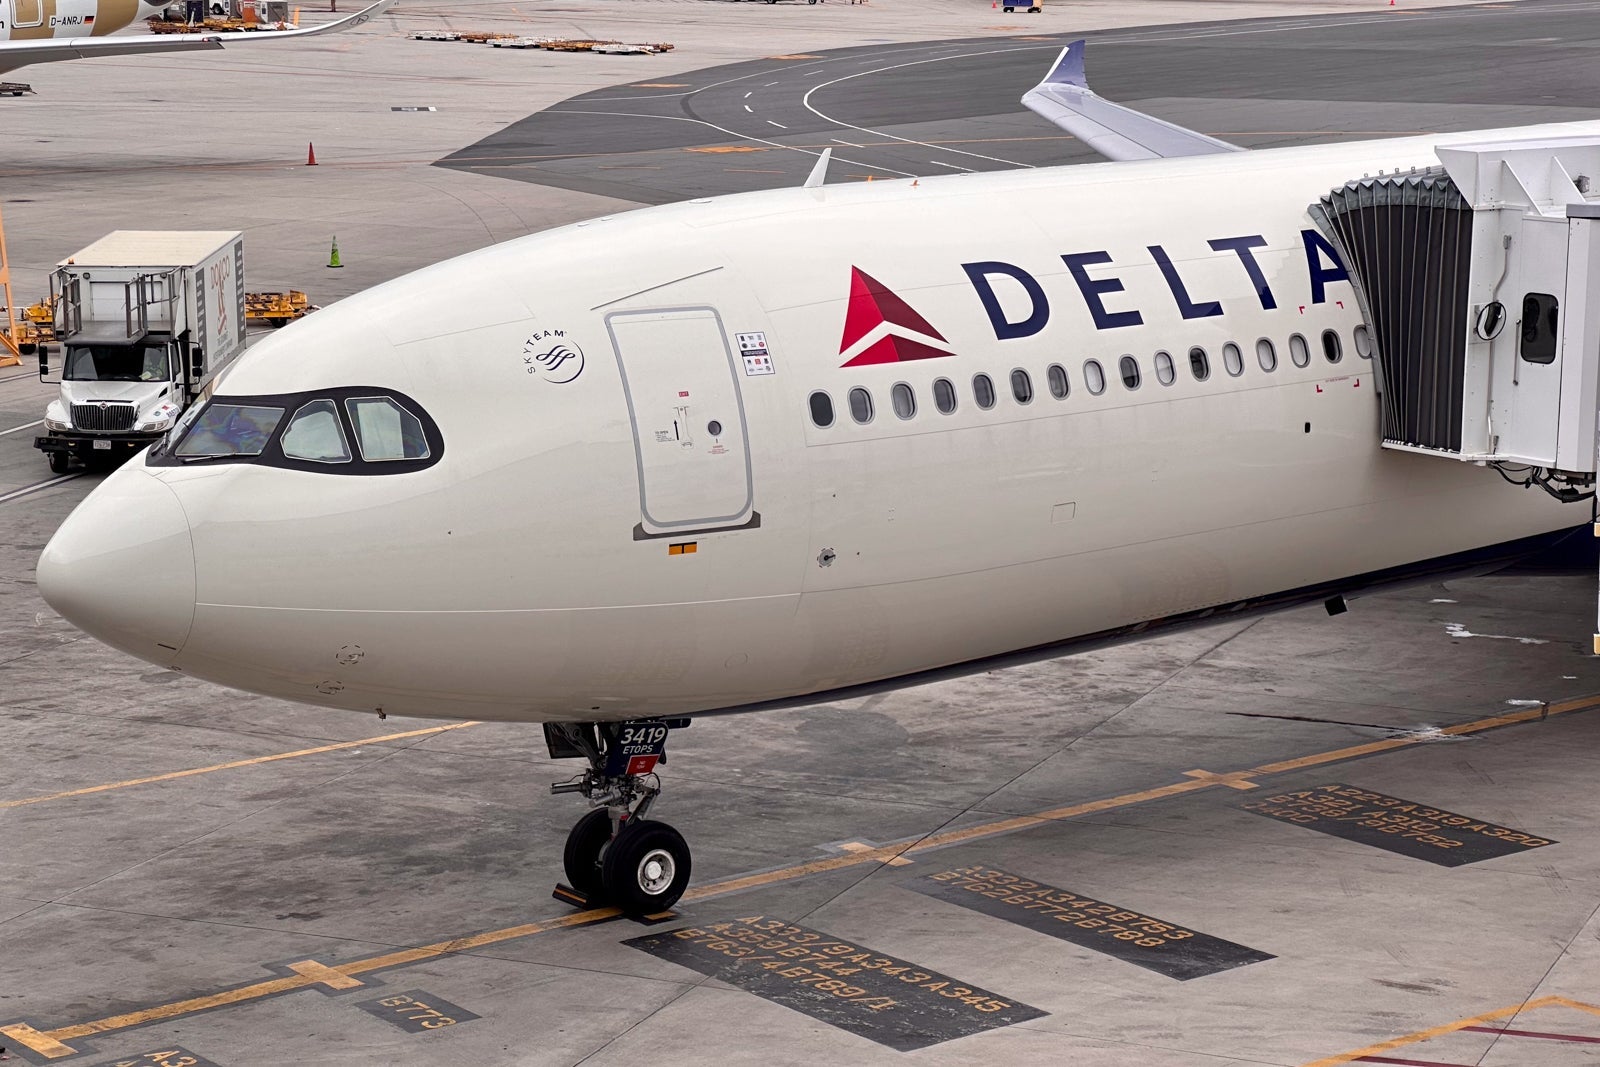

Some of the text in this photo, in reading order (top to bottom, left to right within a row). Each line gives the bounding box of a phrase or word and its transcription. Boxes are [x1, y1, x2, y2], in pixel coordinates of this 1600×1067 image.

[51, 16, 82, 26] D-ANRJ
[960, 228, 1351, 341] DELTA
[523, 329, 564, 374] SKYTEAM
[621, 726, 666, 744] 3419
[622, 744, 654, 754] ETOPS
